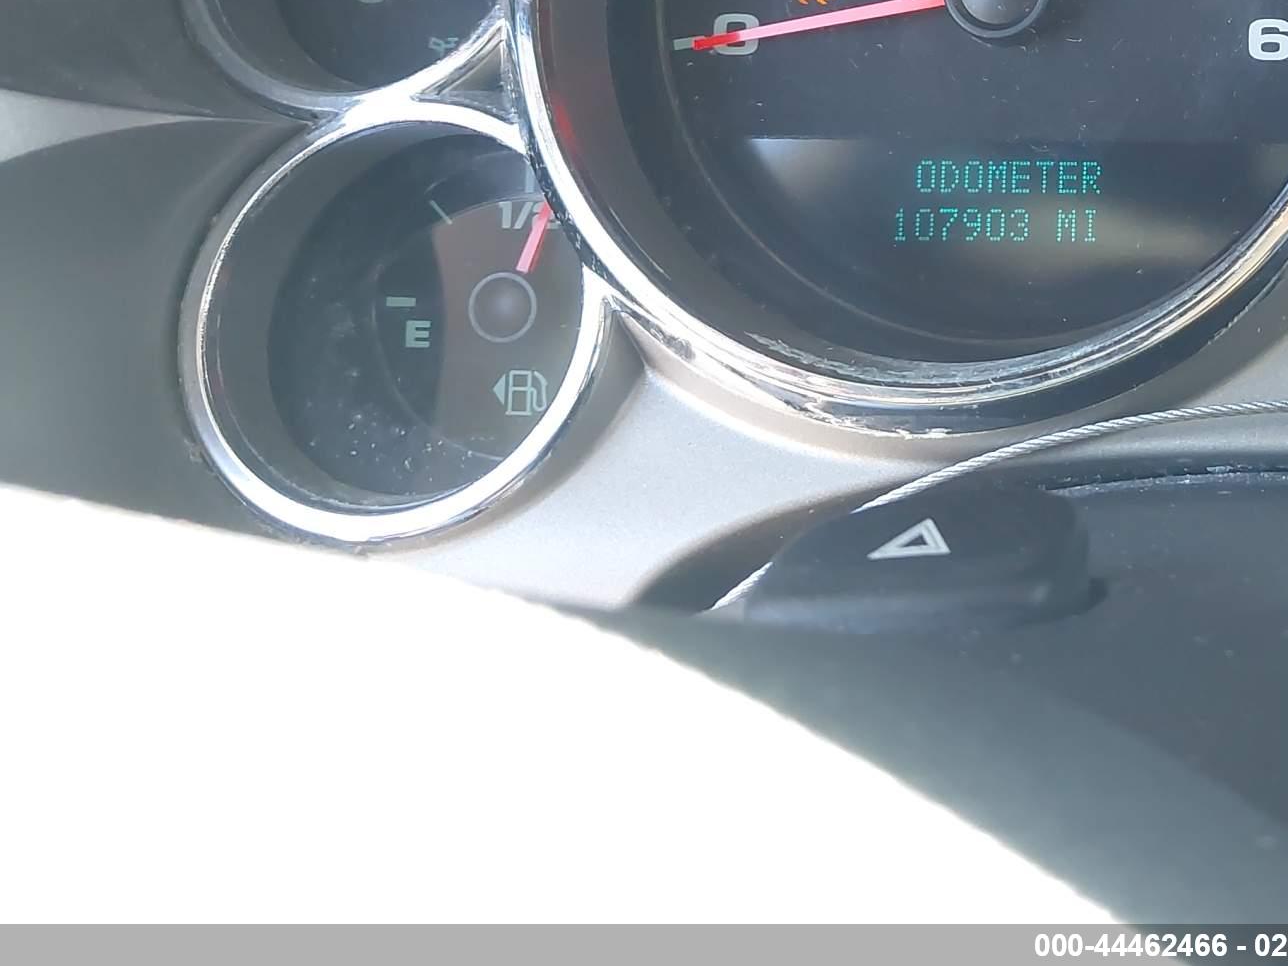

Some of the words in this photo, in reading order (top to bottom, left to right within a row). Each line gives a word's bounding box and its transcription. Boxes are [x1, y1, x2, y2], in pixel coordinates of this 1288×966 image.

[713, 13, 761, 56] 0
[916, 160, 1101, 194] ODOMETER
[895, 208, 1029, 241] 107903
[1056, 209, 1096, 242] MI
[405, 320, 431, 348] E
